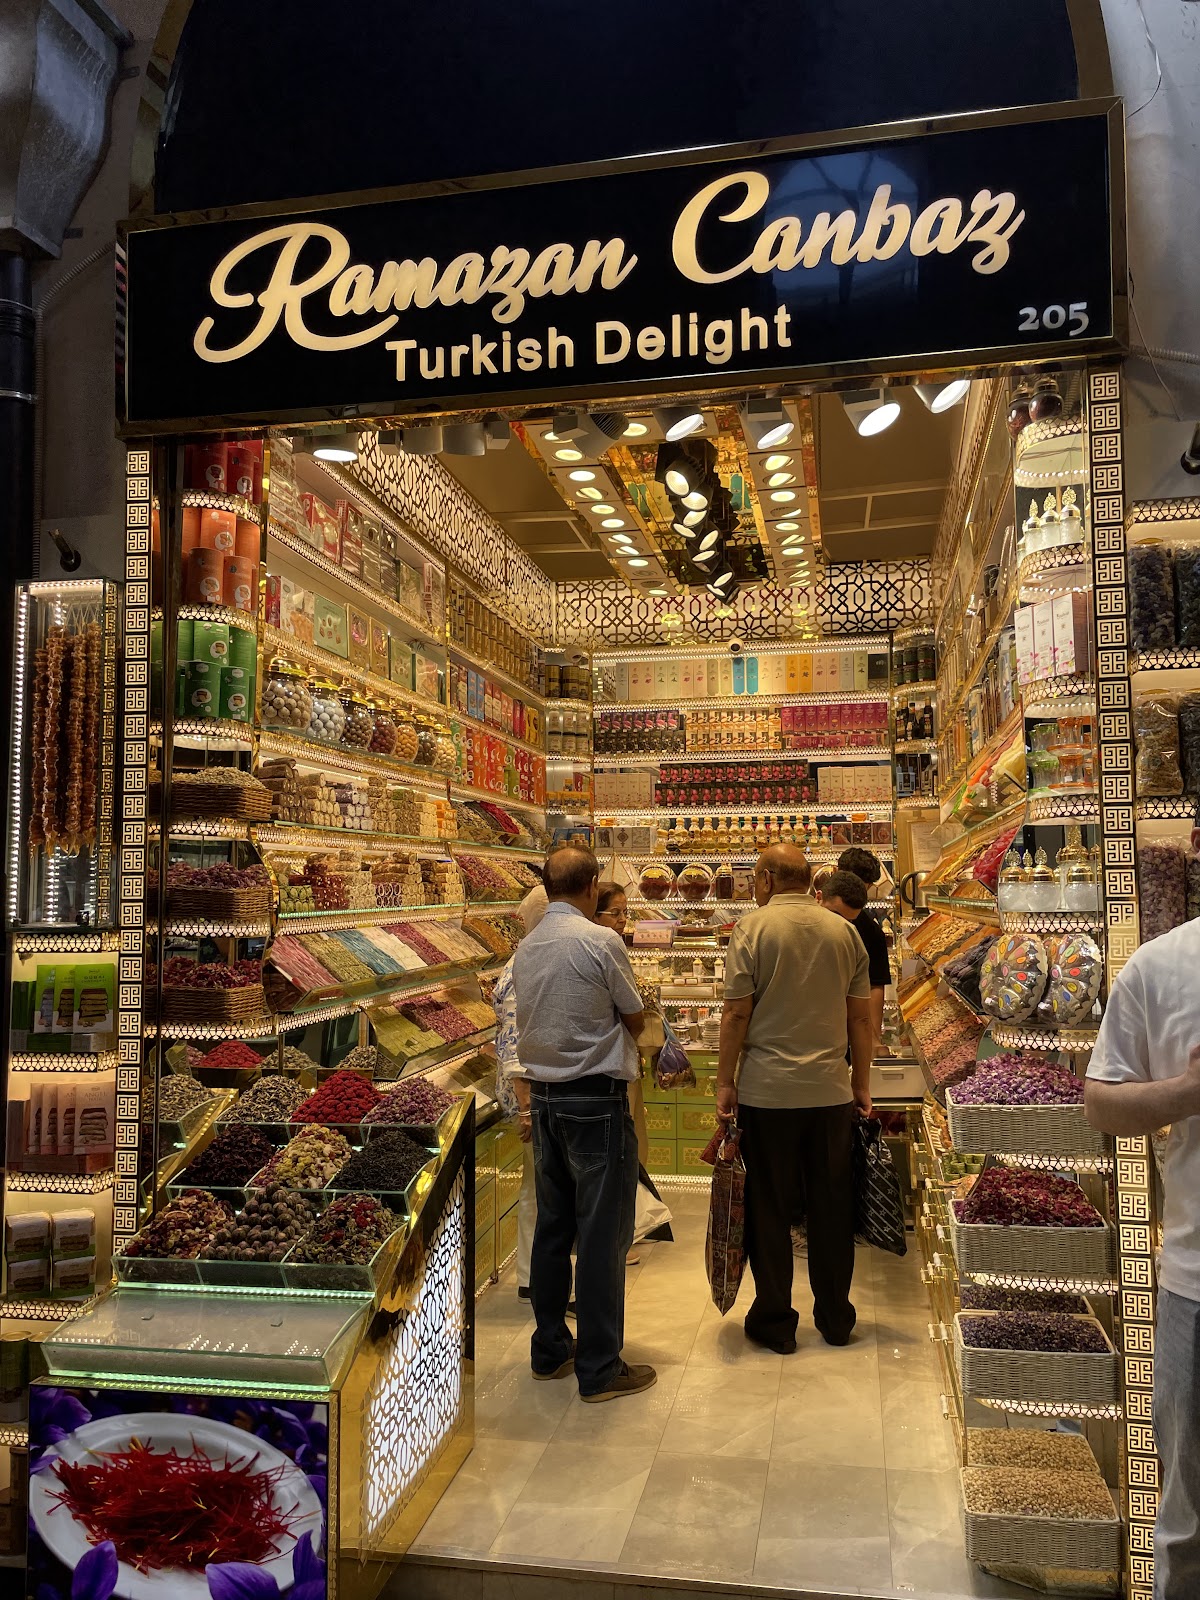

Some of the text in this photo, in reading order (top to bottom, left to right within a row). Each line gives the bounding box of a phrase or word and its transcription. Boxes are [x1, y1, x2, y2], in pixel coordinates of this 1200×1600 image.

[193, 171, 1026, 364] Ramazan Canbaz
[385, 304, 793, 383] Turkish Delight
[1018, 302, 1089, 336] 205
